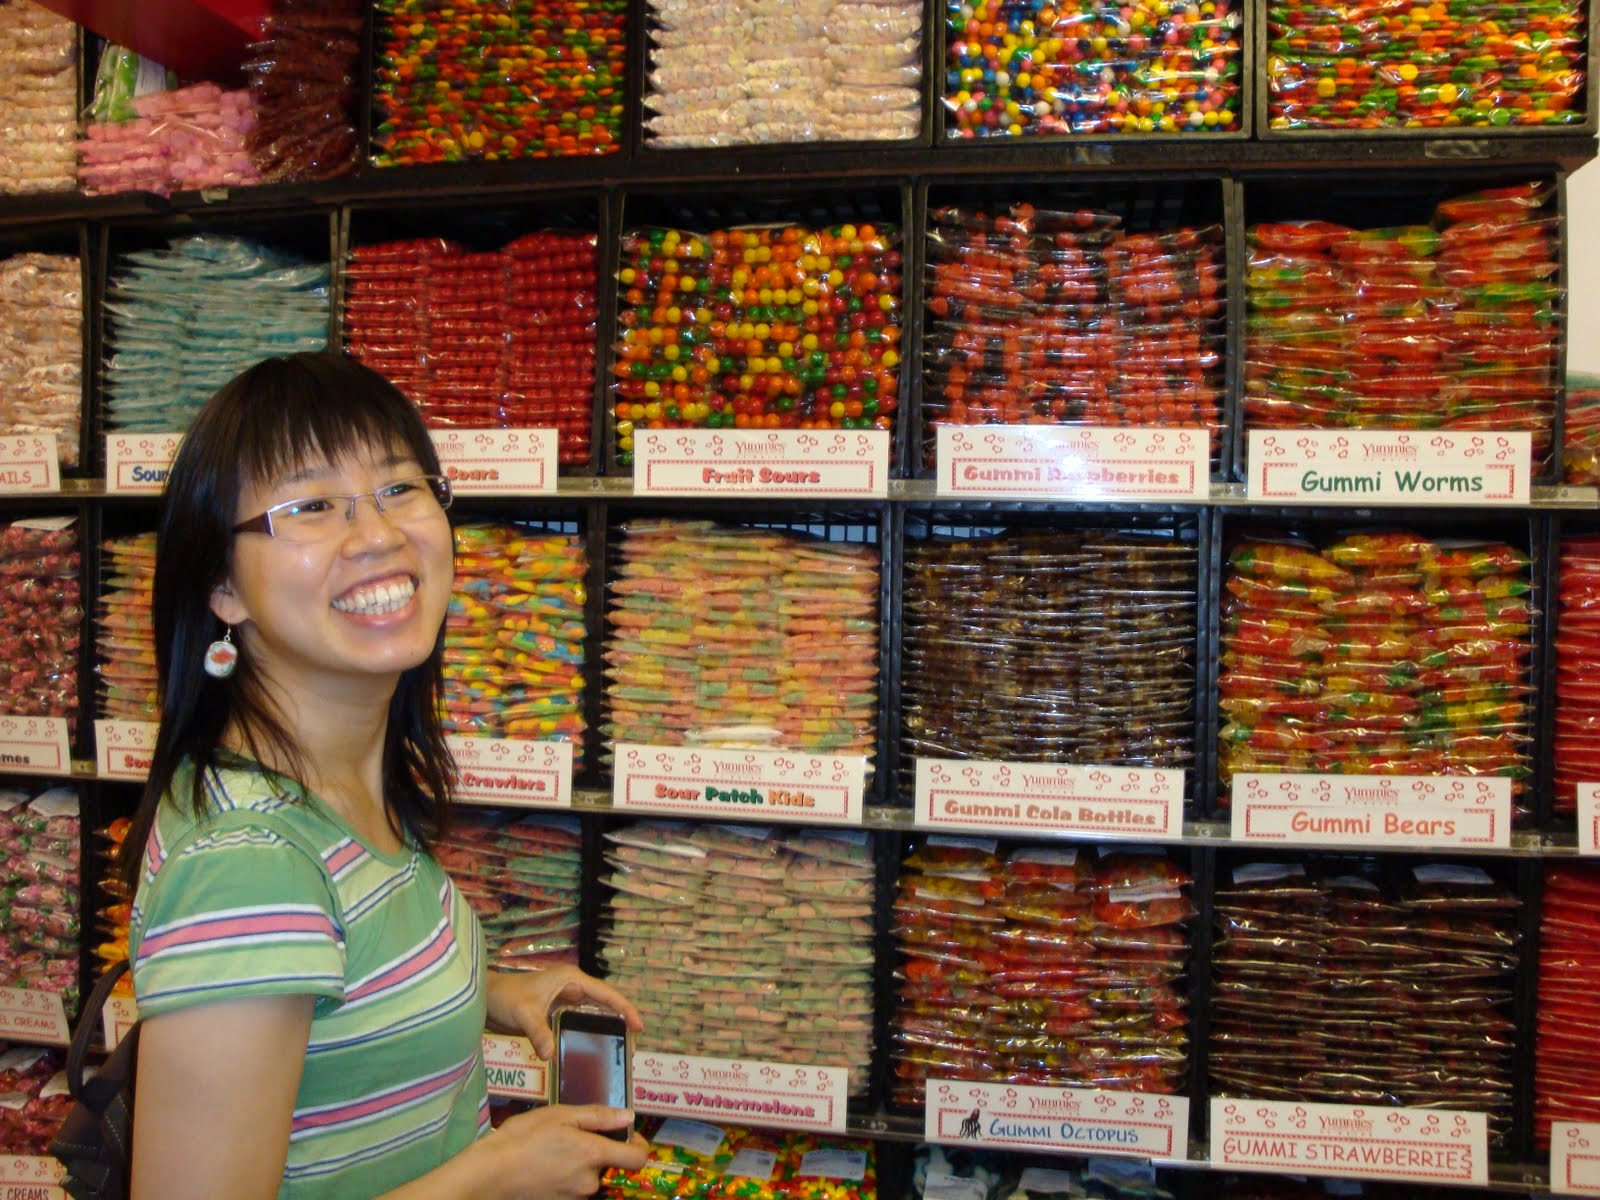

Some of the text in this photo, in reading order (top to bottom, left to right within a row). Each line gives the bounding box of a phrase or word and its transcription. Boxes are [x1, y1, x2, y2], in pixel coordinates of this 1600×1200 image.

[734, 441, 786, 454] Yummies
[1362, 443, 1417, 456] Yummies
[447, 466, 499, 480] Sours
[702, 467, 820, 484] Fruit Sours
[963, 465, 1180, 485] Gummi Rpberries
[1301, 470, 1483, 492] Gummi Worms
[0, 754, 30, 764] mes
[712, 760, 762, 773] Yummies
[463, 772, 546, 791] Crawlers
[1022, 774, 1076, 788] Yummies
[655, 783, 815, 807] Sour Patch Kids
[1344, 787, 1399, 800] Yummies
[944, 799, 1156, 825] Gummi Cola Bottles
[1291, 811, 1456, 836] Gummi Bears
[701, 1067, 749, 1081] Yummies
[634, 1086, 815, 1118] Sour Watermelons
[1029, 1096, 1081, 1110] Yummies
[1319, 1114, 1374, 1129] Yummies
[1223, 1137, 1473, 1171] GUMMI STRAWBERRIES
